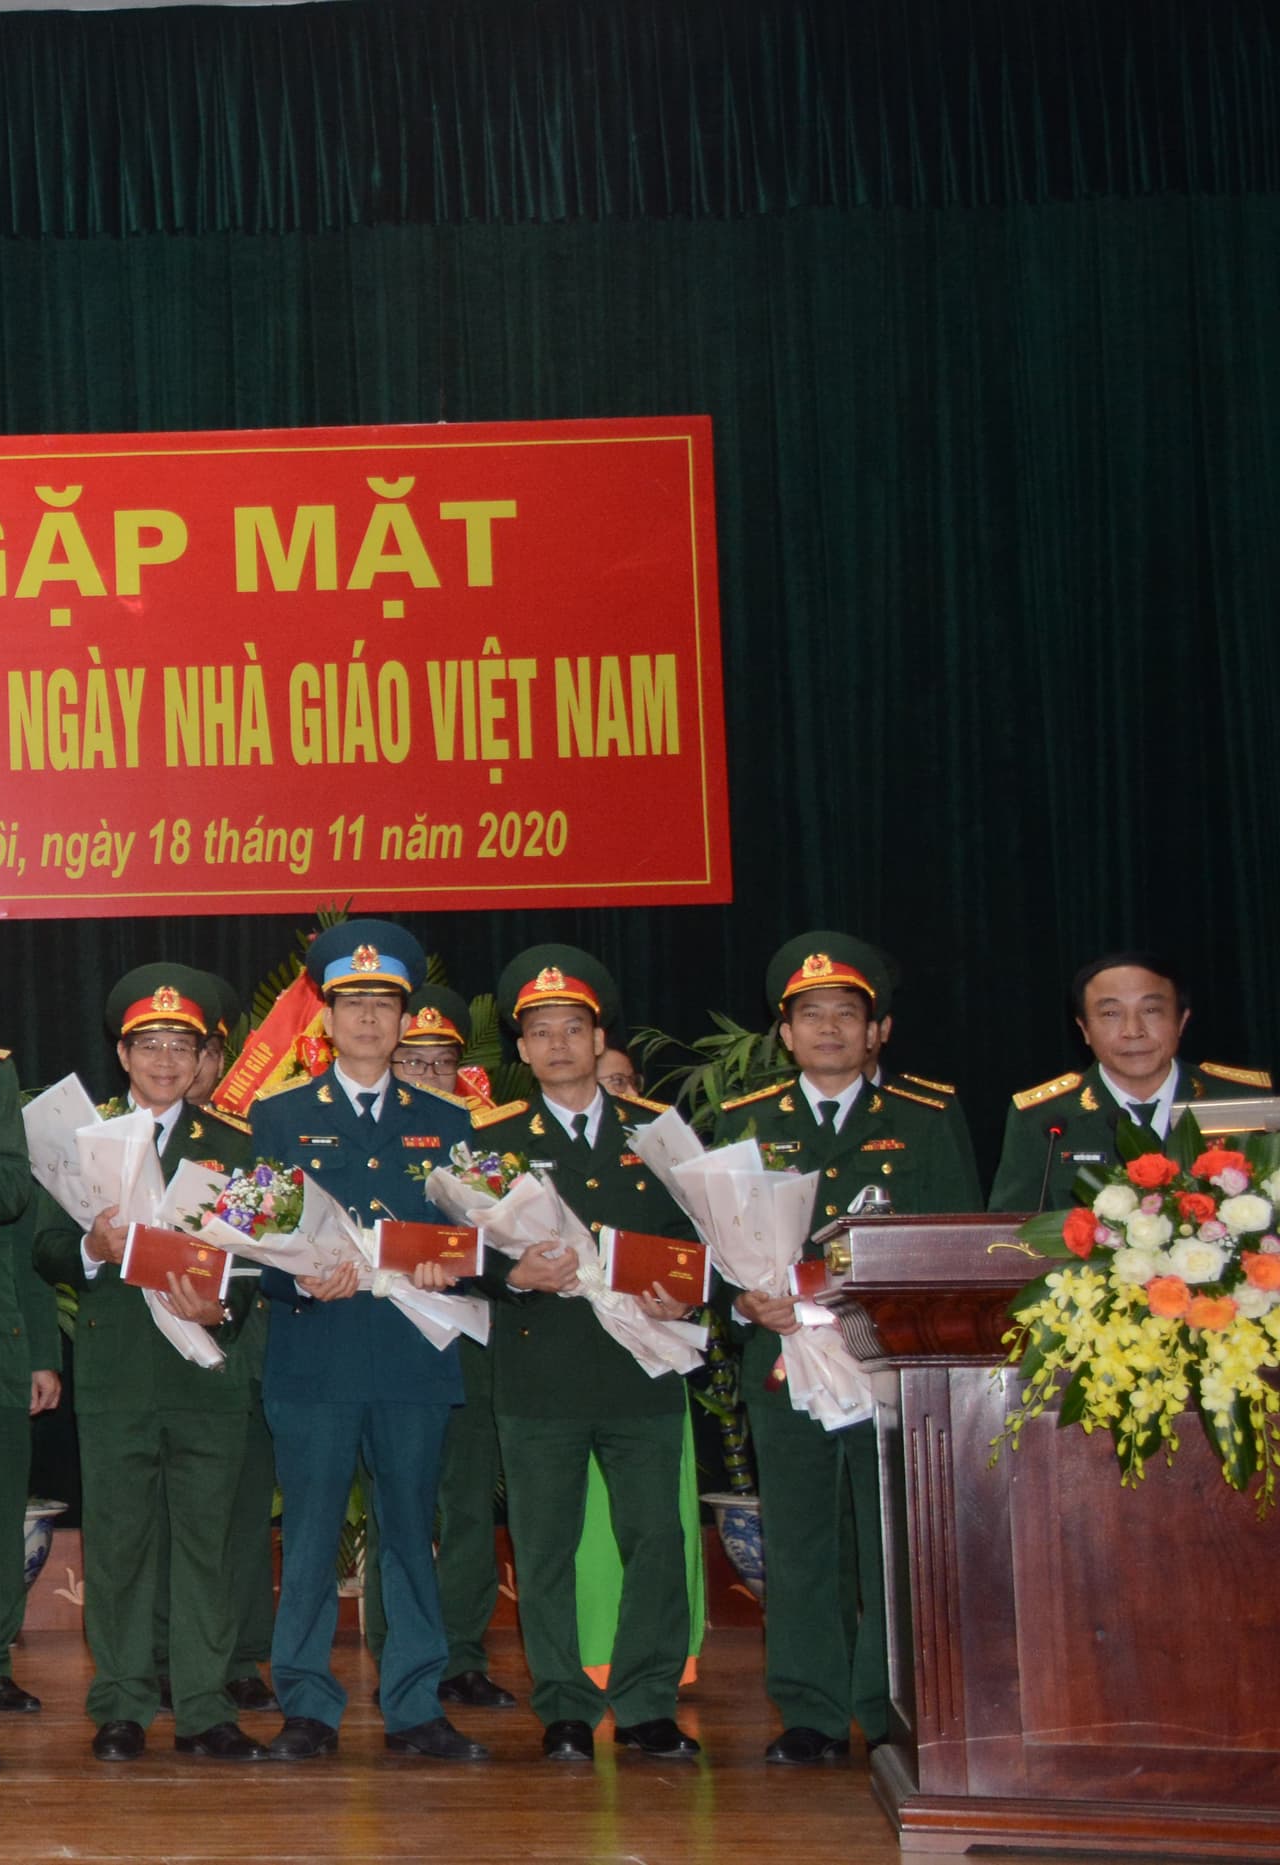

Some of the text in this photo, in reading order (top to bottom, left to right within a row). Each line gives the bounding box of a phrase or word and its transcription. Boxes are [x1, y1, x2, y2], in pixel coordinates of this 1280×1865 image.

[233, 475, 517, 619] MẶT
[7, 645, 146, 772] NGÀY
[163, 642, 274, 768] NHÀ
[289, 639, 411, 766] GIÁO
[426, 636, 537, 784] VIỆT
[554, 654, 680, 758] NAM
[40, 818, 137, 880] ngày
[149, 817, 193, 866] 18
[204, 814, 314, 875] tháng
[328, 814, 366, 861] 11
[380, 812, 463, 861] năm
[477, 810, 569, 858] 2020
[223, 1041, 274, 1105] THIẾT GIÁP
